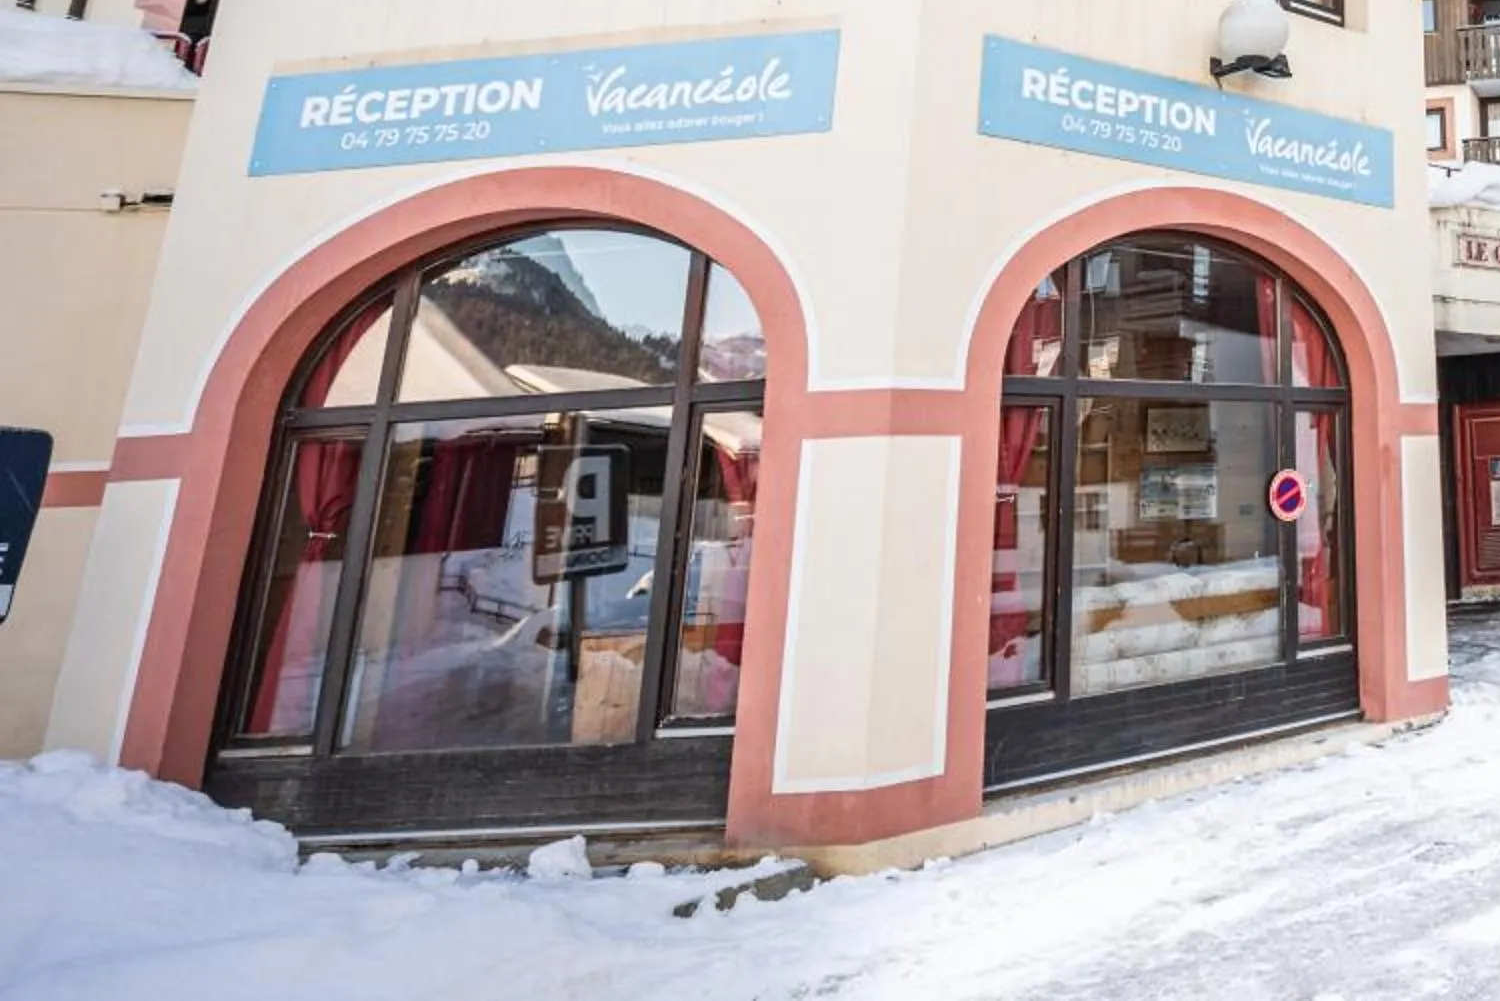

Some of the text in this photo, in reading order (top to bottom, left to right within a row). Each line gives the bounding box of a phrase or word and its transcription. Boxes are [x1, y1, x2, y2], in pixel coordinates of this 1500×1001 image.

[300, 58, 793, 128] RÉCEPTION Vacancéole
[340, 120, 490, 149] 04 79 75 75 20
[1022, 67, 1372, 176] RÉCEPTION Vacancéole
[1061, 113, 1182, 152] 04 79 75 75 20
[1466, 240, 1489, 261] LE
